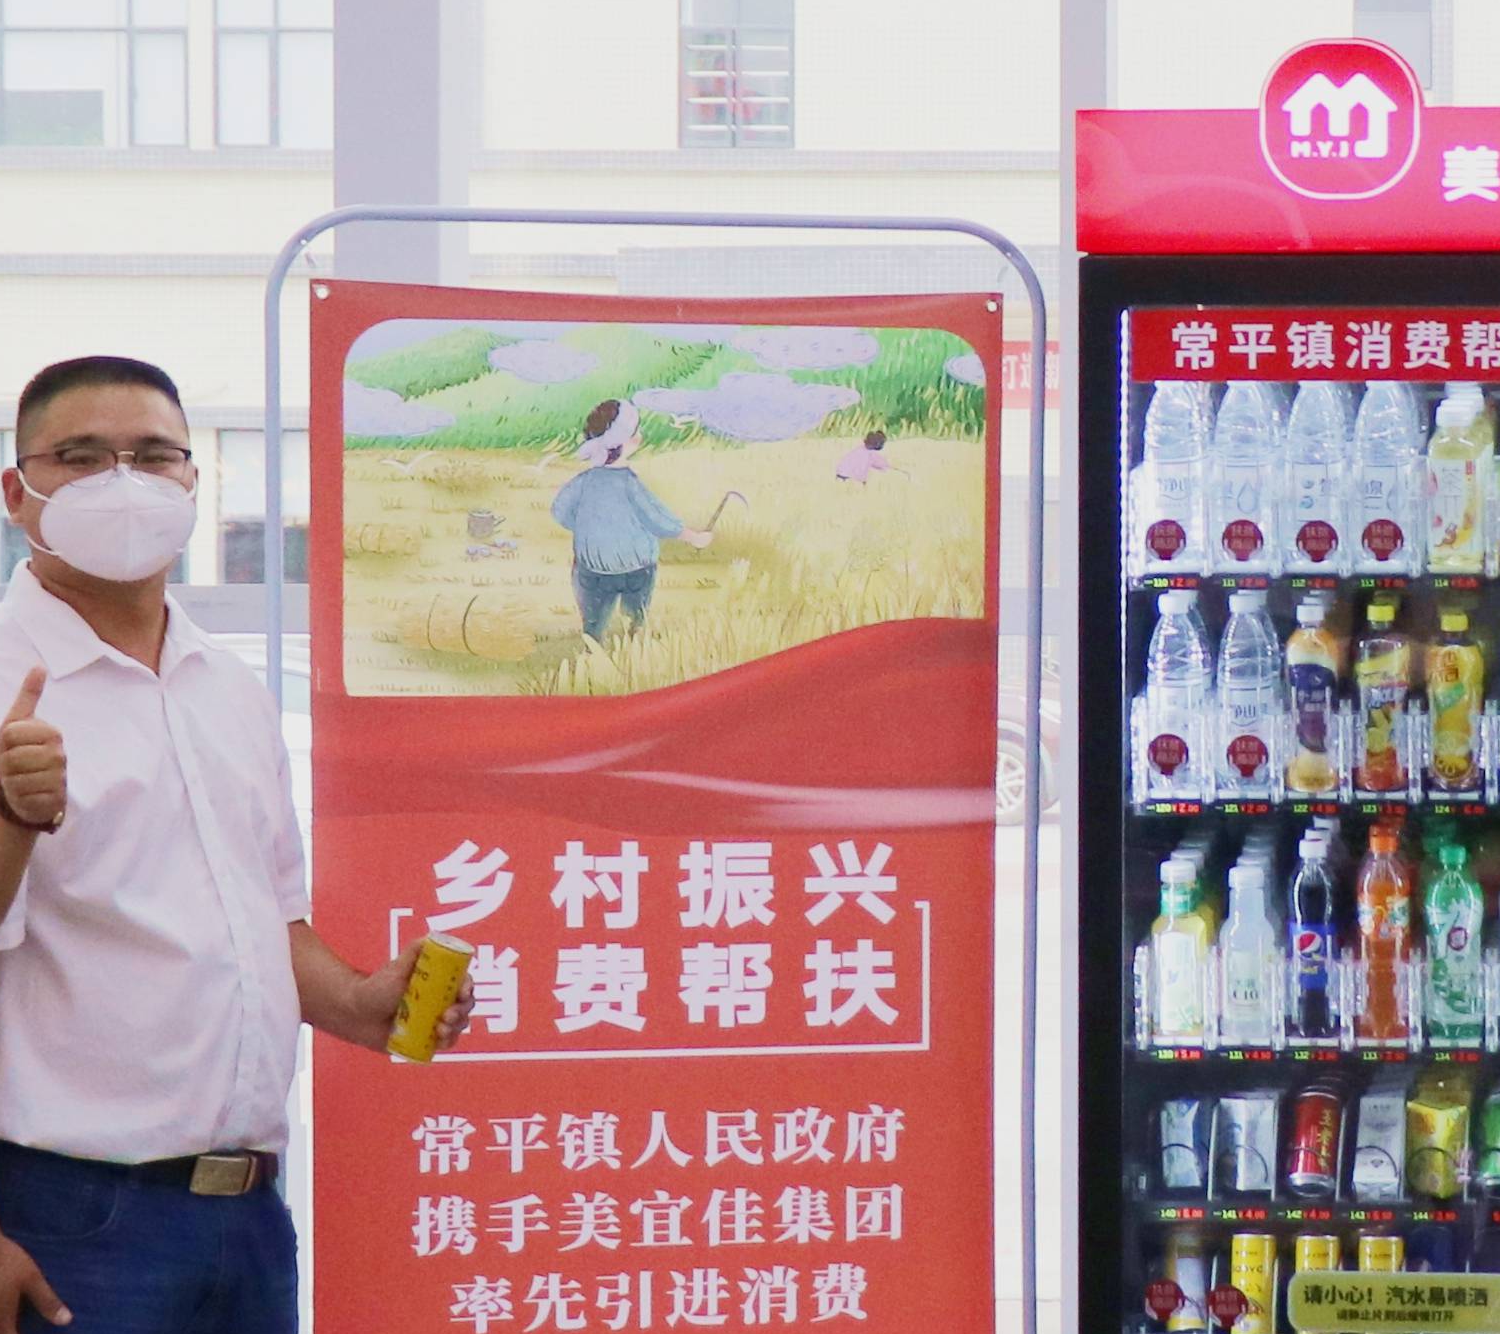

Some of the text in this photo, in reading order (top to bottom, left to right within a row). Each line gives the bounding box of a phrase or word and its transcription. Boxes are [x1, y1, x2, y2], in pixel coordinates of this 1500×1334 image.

[426, 839, 898, 933] 乡村振兴
[411, 1104, 906, 1176] 常平镇人民政府
[411, 1183, 905, 1259] 携手美宜佳集团
